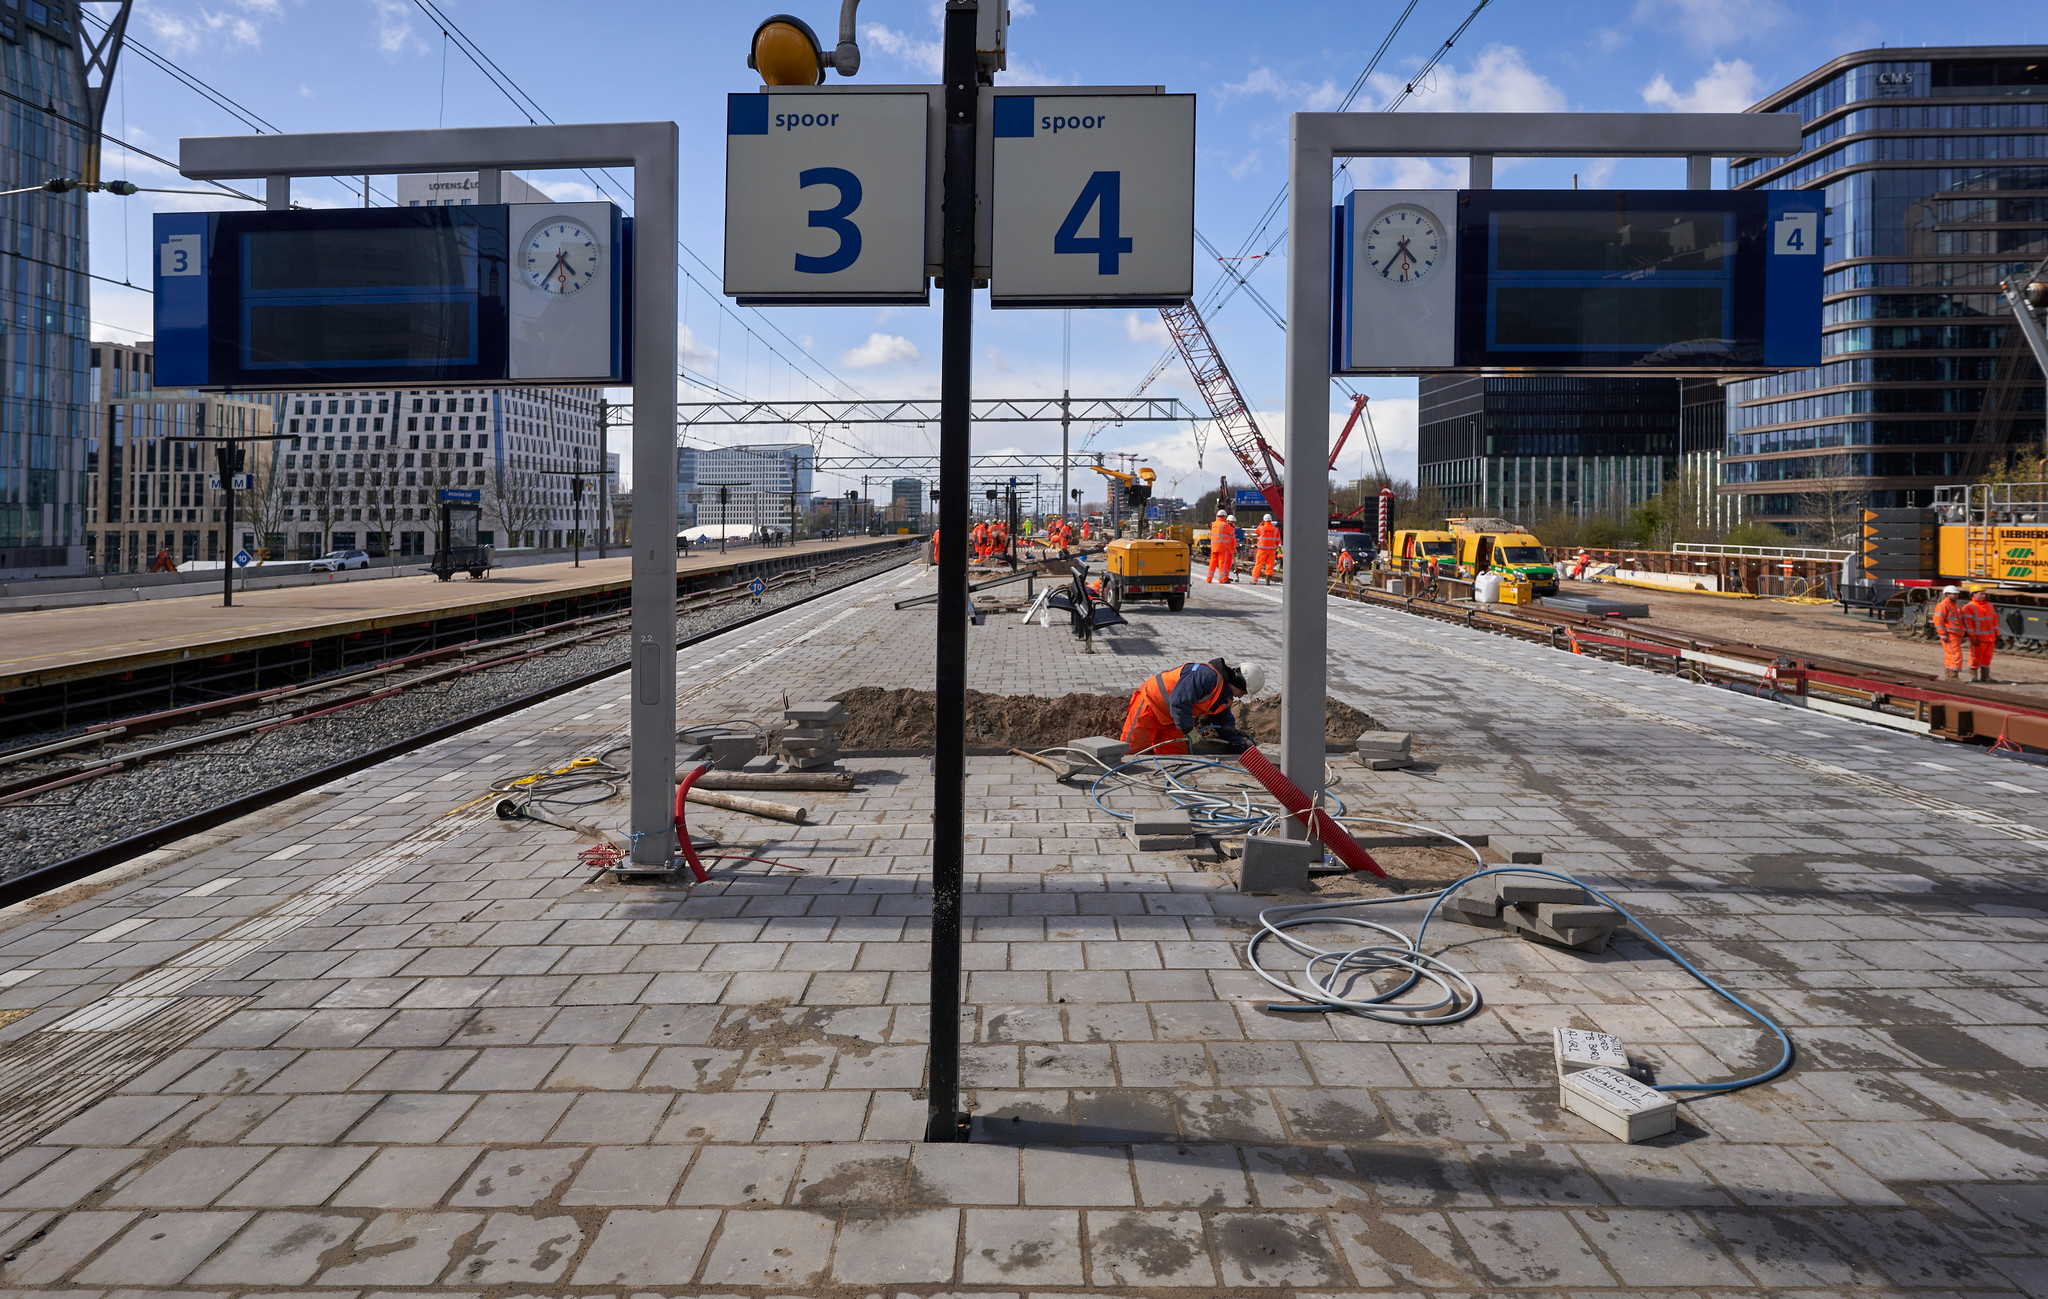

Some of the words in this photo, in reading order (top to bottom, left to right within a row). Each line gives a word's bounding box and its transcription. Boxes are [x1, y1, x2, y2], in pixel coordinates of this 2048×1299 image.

[1879, 73, 1913, 84] CMS
[775, 110, 840, 131] spoor
[1041, 112, 1106, 134] spoor
[429, 182, 462, 190] LOYENS
[794, 166, 863, 274] 3
[1053, 170, 1133, 275] 4
[1786, 228, 1804, 251] 4
[173, 249, 188, 273] 3
[211, 480, 221, 488] M
[234, 479, 244, 488] M
[238, 555, 247, 563] 10
[751, 583, 762, 592] 10
